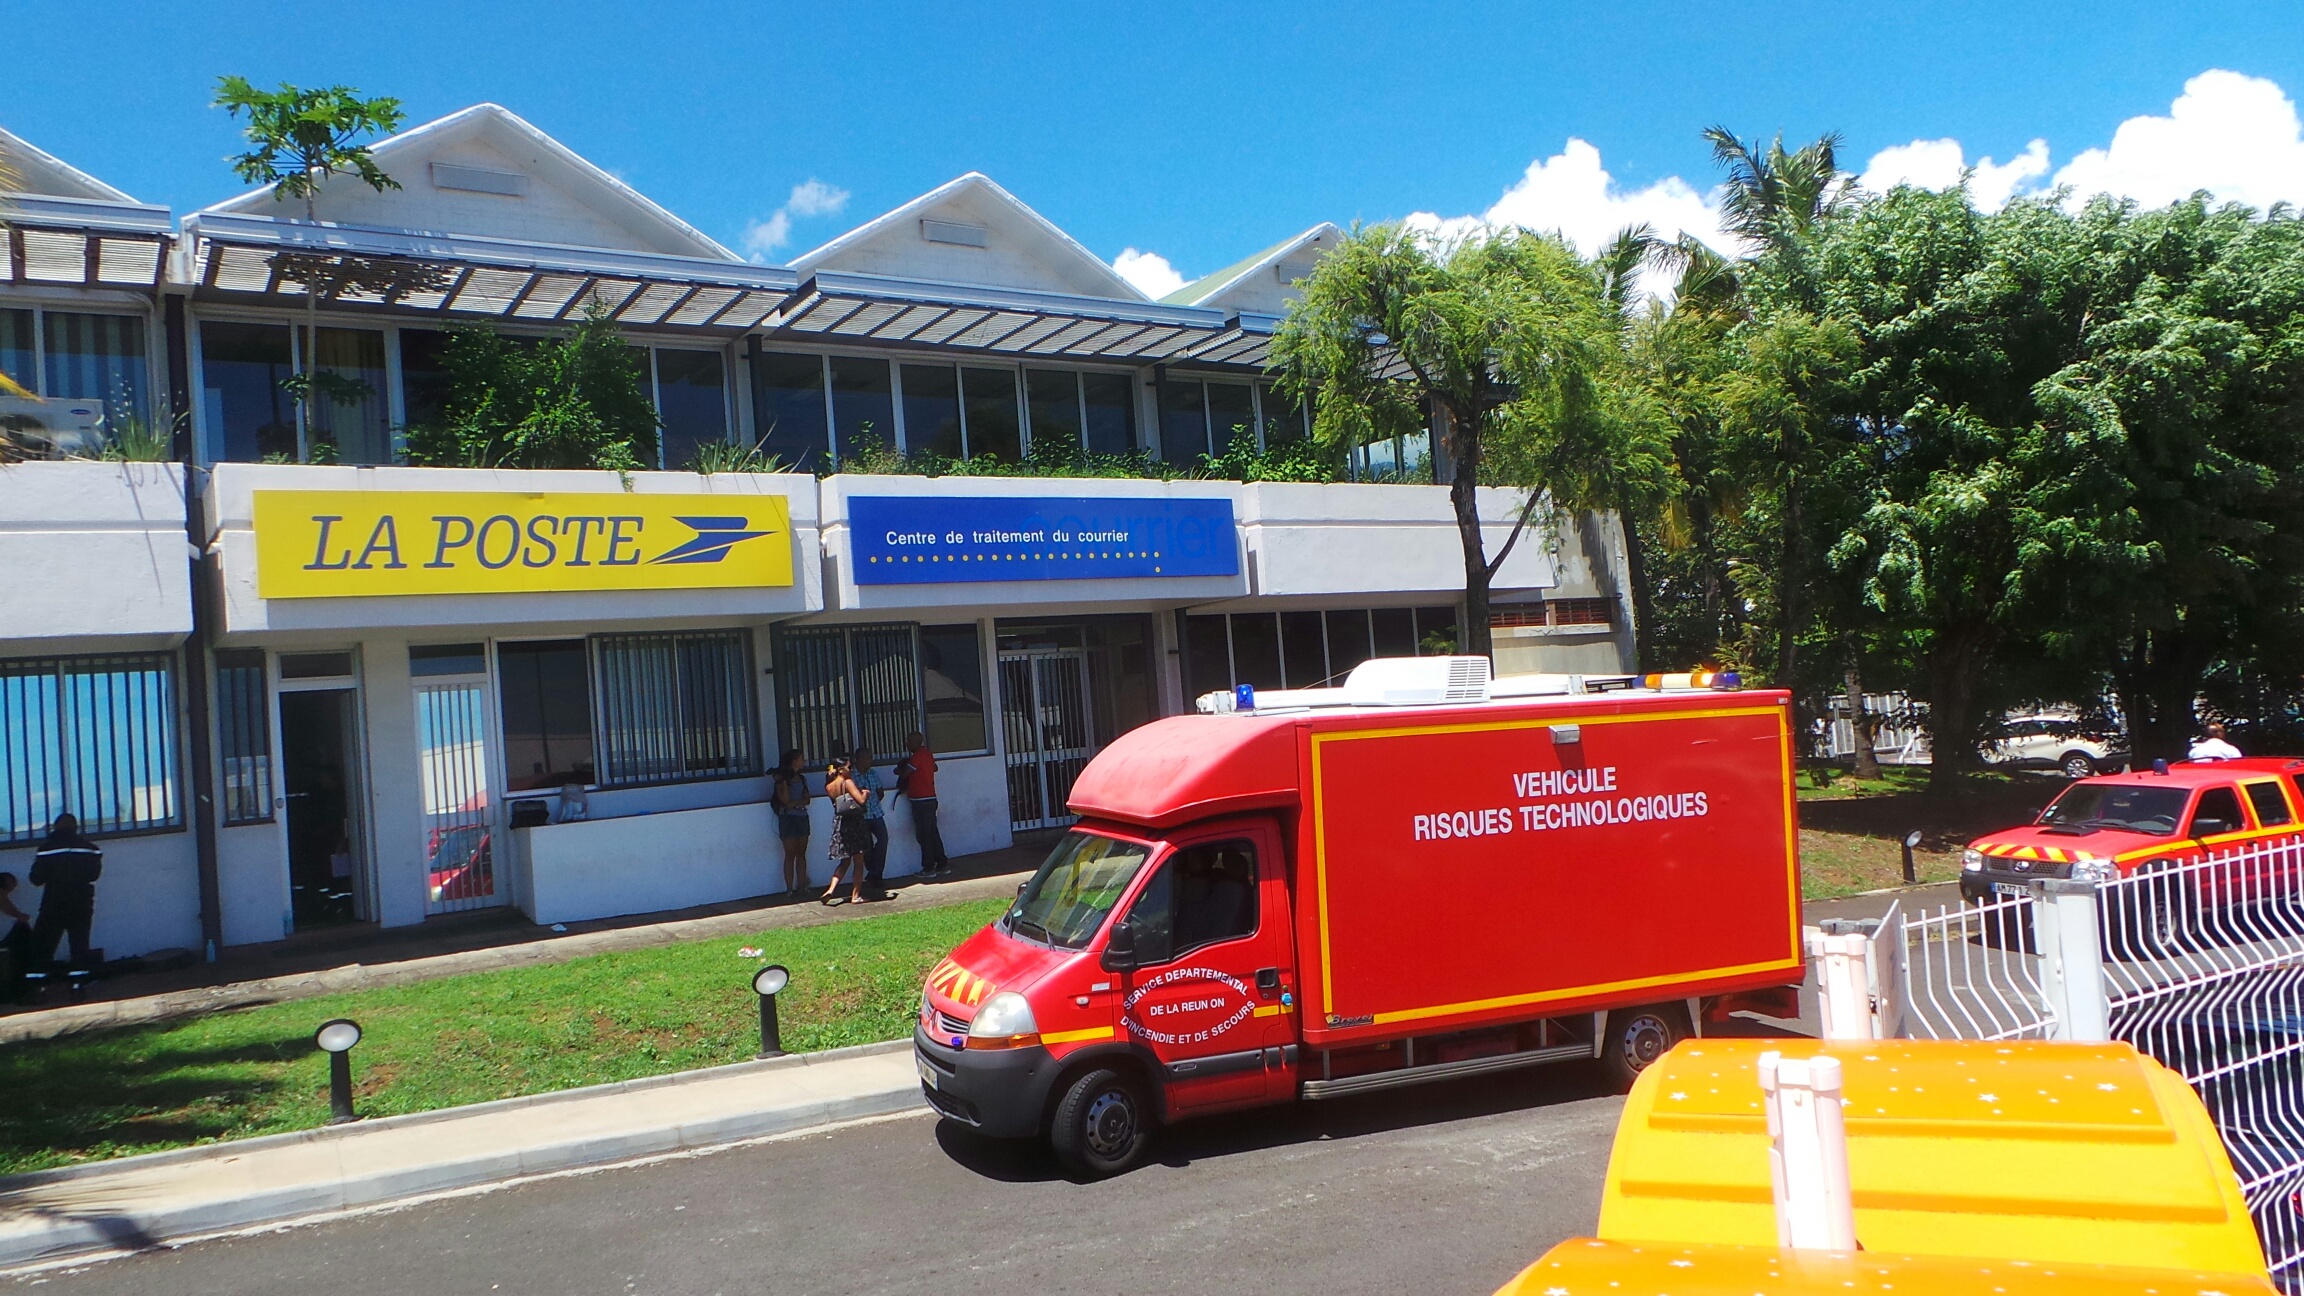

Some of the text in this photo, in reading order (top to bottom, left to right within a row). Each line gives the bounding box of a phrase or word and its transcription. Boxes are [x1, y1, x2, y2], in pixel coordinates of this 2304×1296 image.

[302, 514, 645, 571] LA POSTE
[885, 528, 1129, 546] Centre de traitement du courrier
[1512, 766, 1617, 798] VEHICULE
[1413, 791, 1708, 841] RISQUES TECHNOLOGIQUES
[1123, 967, 1248, 1010] SERVICE DEPARTEMENTAL
[1150, 1005, 1164, 1016] DE
[1166, 1003, 1179, 1014] LA
[1120, 1000, 1256, 1045] D'INCENDIE ET DE SECOURS
